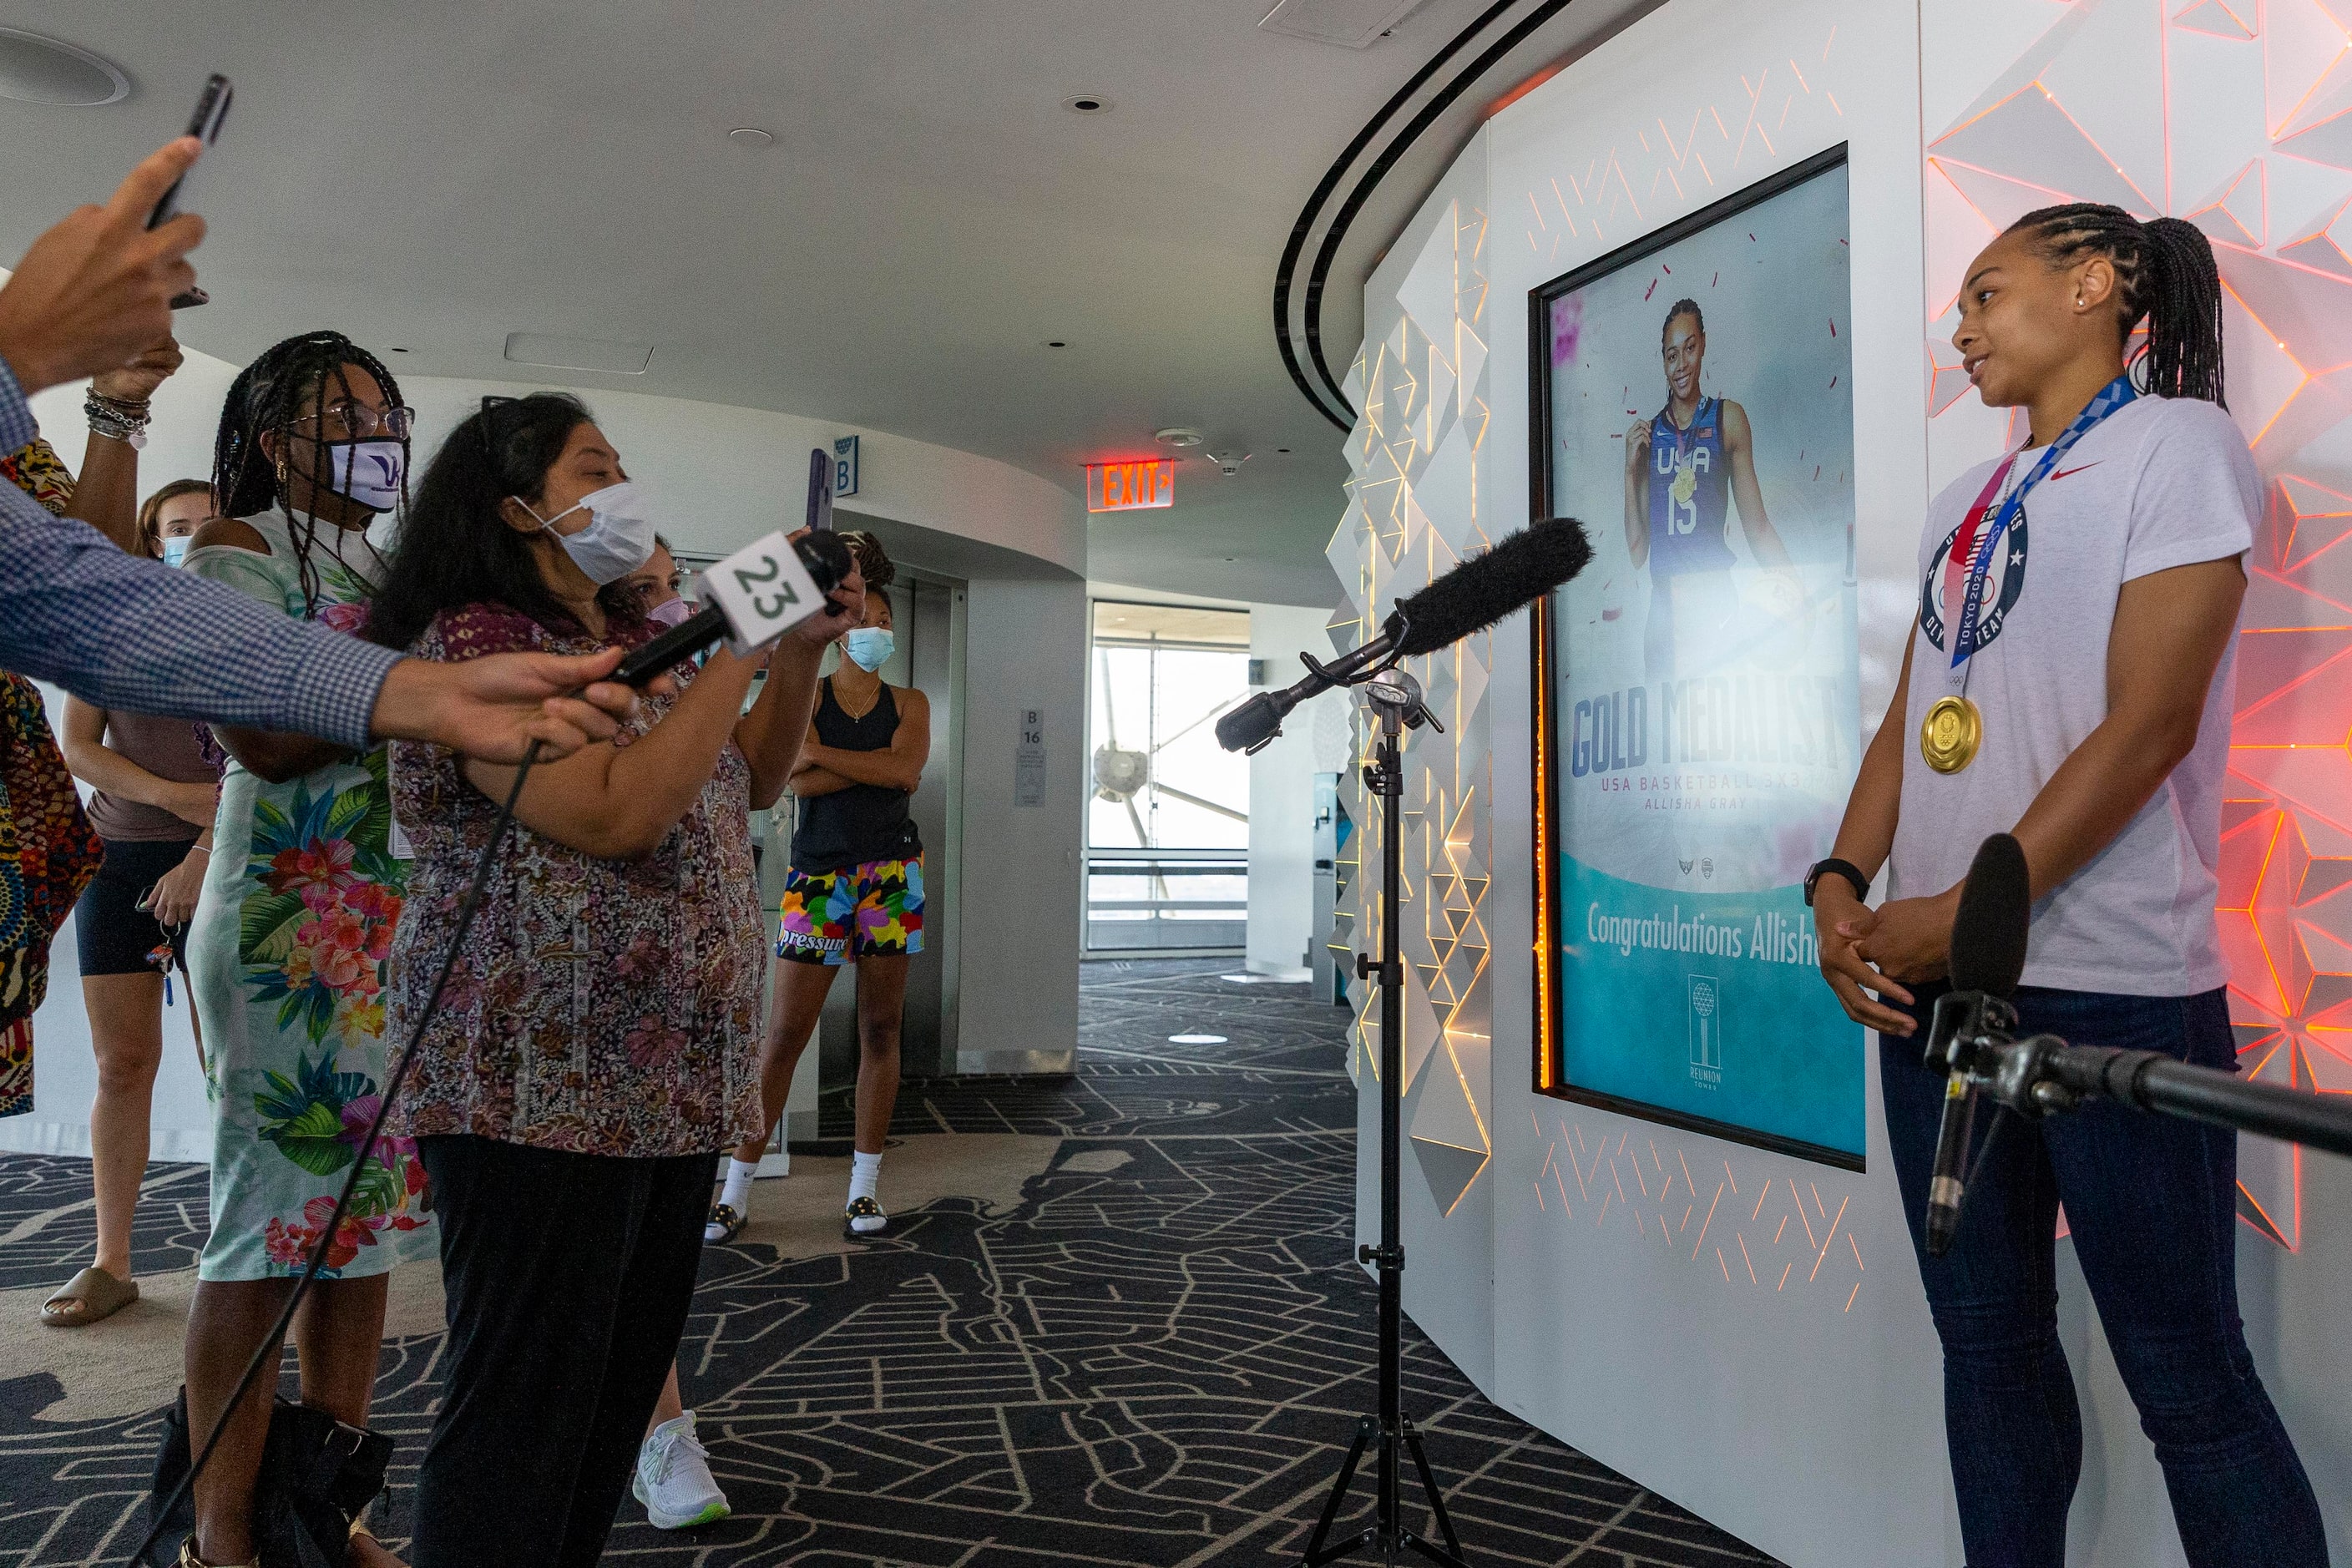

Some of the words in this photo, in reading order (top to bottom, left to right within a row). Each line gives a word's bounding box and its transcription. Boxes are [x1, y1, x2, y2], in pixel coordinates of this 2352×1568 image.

[837, 460, 849, 491] B
[1103, 462, 1160, 507] EXIT
[733, 554, 801, 620] 23
[1960, 603, 1976, 647] TOKYO
[1970, 565, 1985, 599] 2020
[1028, 711, 1037, 724] B
[1571, 685, 1648, 778] GOLD
[1662, 675, 1839, 770] MEDALIST
[1024, 731, 1039, 744] 16
[1601, 777, 1631, 792] USA
[1640, 773, 1753, 792] BASKETBALL
[1645, 797, 1702, 810] ALLISHA
[1710, 797, 1747, 810] GRAY
[780, 929, 848, 951] pressure
[1588, 902, 1742, 957] Congratulations
[1690, 1066, 1721, 1084] REUNION
[1694, 1080, 1717, 1091] TOWER
